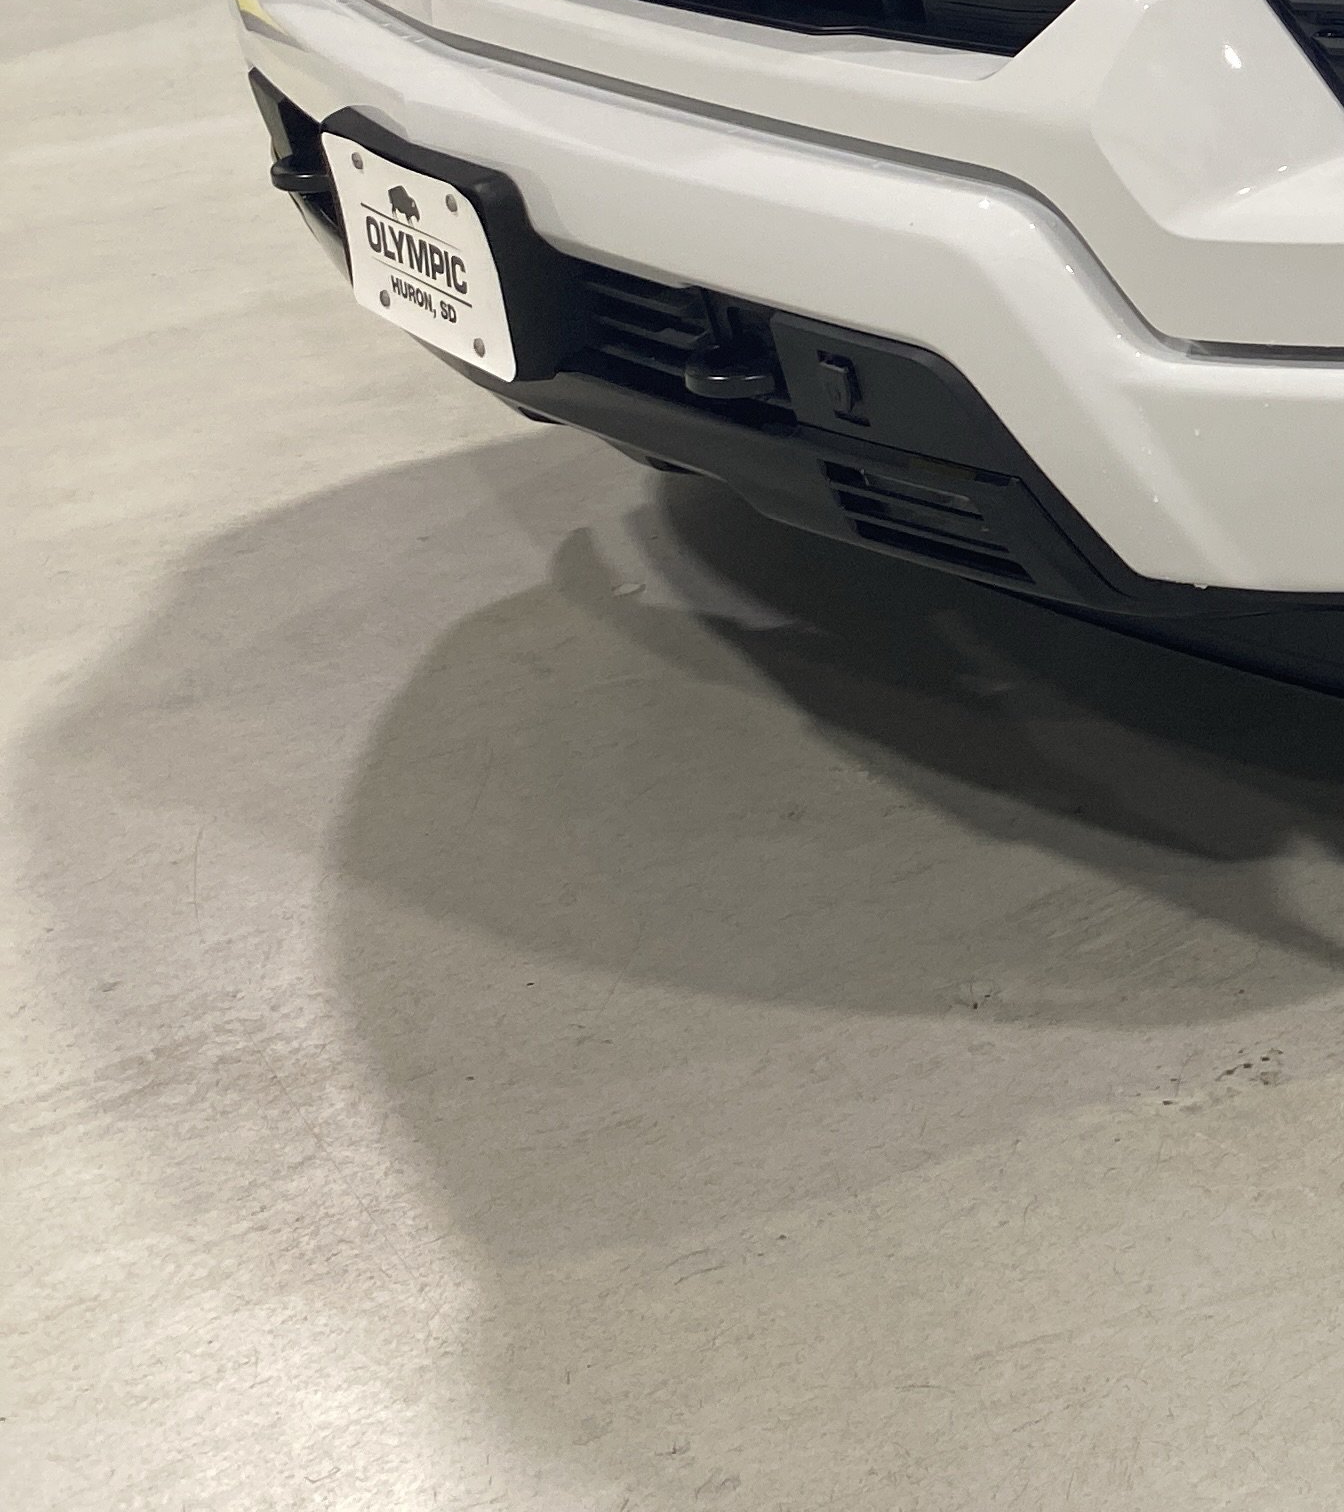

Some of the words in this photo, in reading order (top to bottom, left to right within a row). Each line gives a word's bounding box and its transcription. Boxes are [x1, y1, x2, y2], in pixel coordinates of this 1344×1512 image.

[366, 215, 467, 295] OLYMPIC
[391, 275, 436, 318] HURON,
[440, 301, 456, 323] SD
